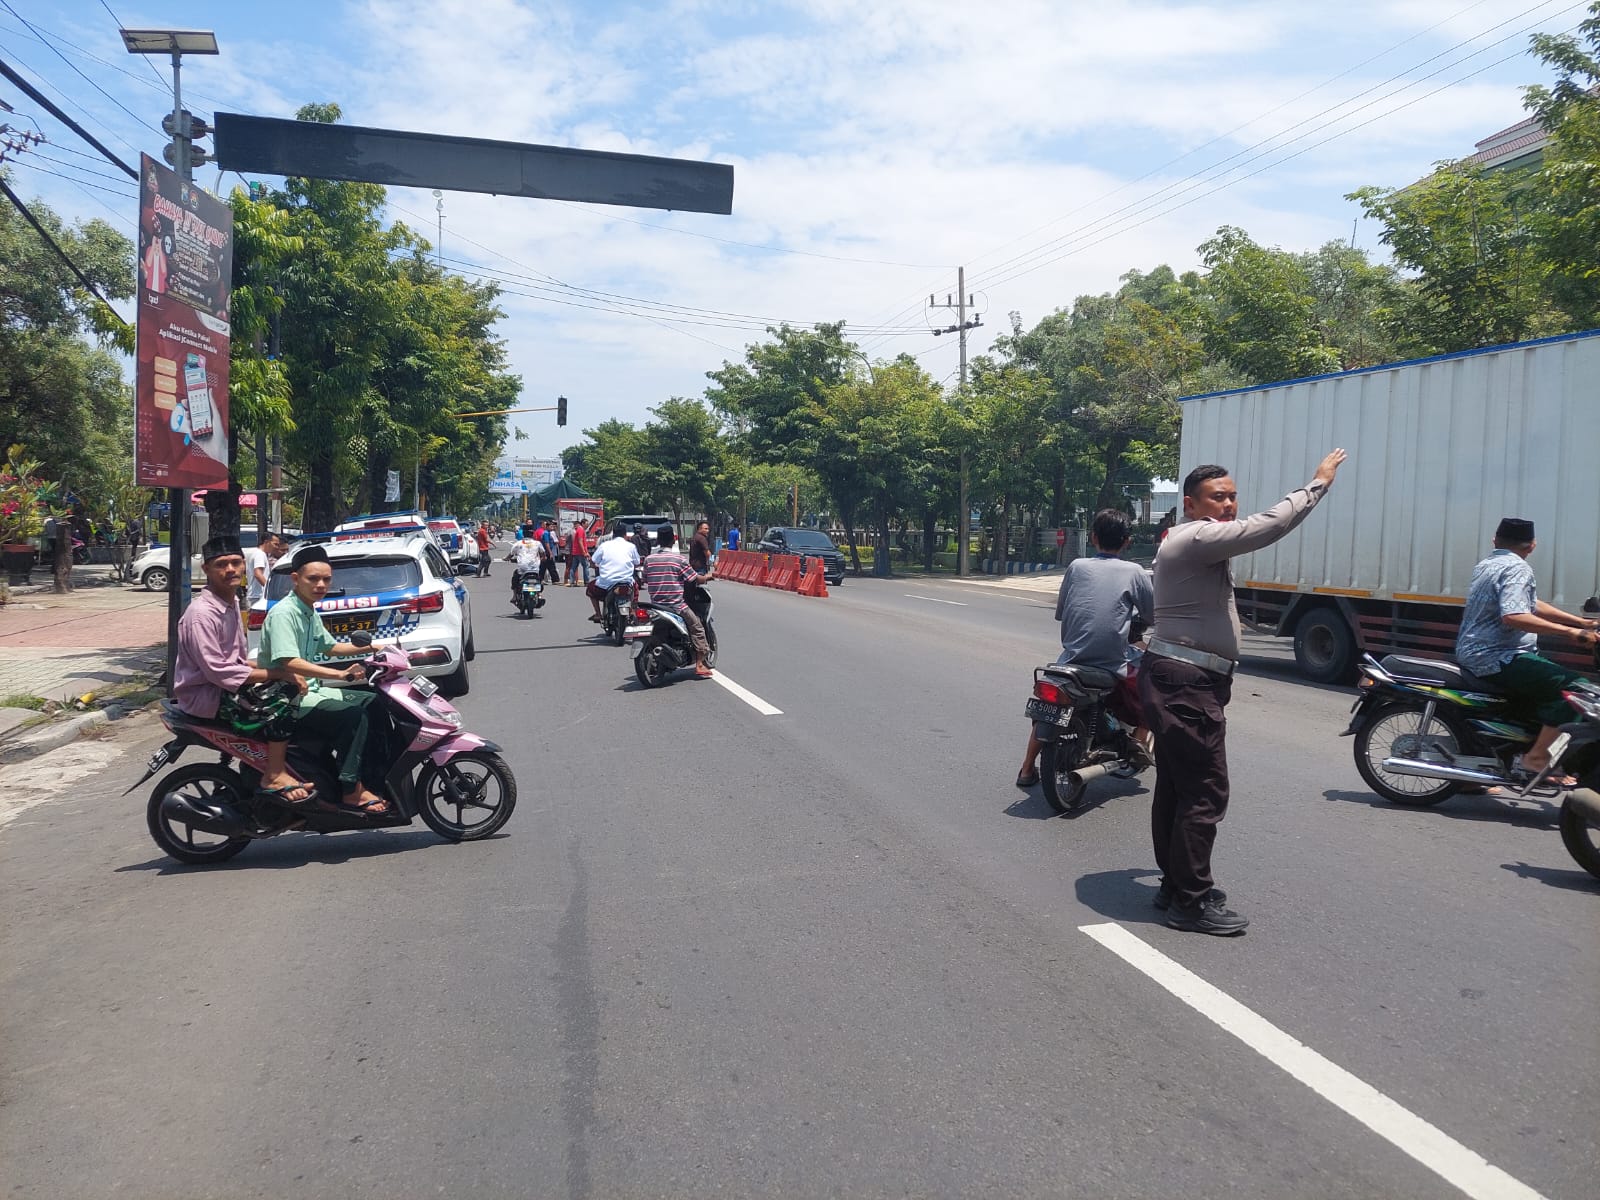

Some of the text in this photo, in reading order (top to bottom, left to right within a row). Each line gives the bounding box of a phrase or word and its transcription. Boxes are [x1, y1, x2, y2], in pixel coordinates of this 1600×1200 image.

[159, 328, 181, 342] Aplikasi
[169, 322, 181, 332] Aku
[181, 327, 197, 338] Ketika
[312, 596, 378, 611] POLISI
